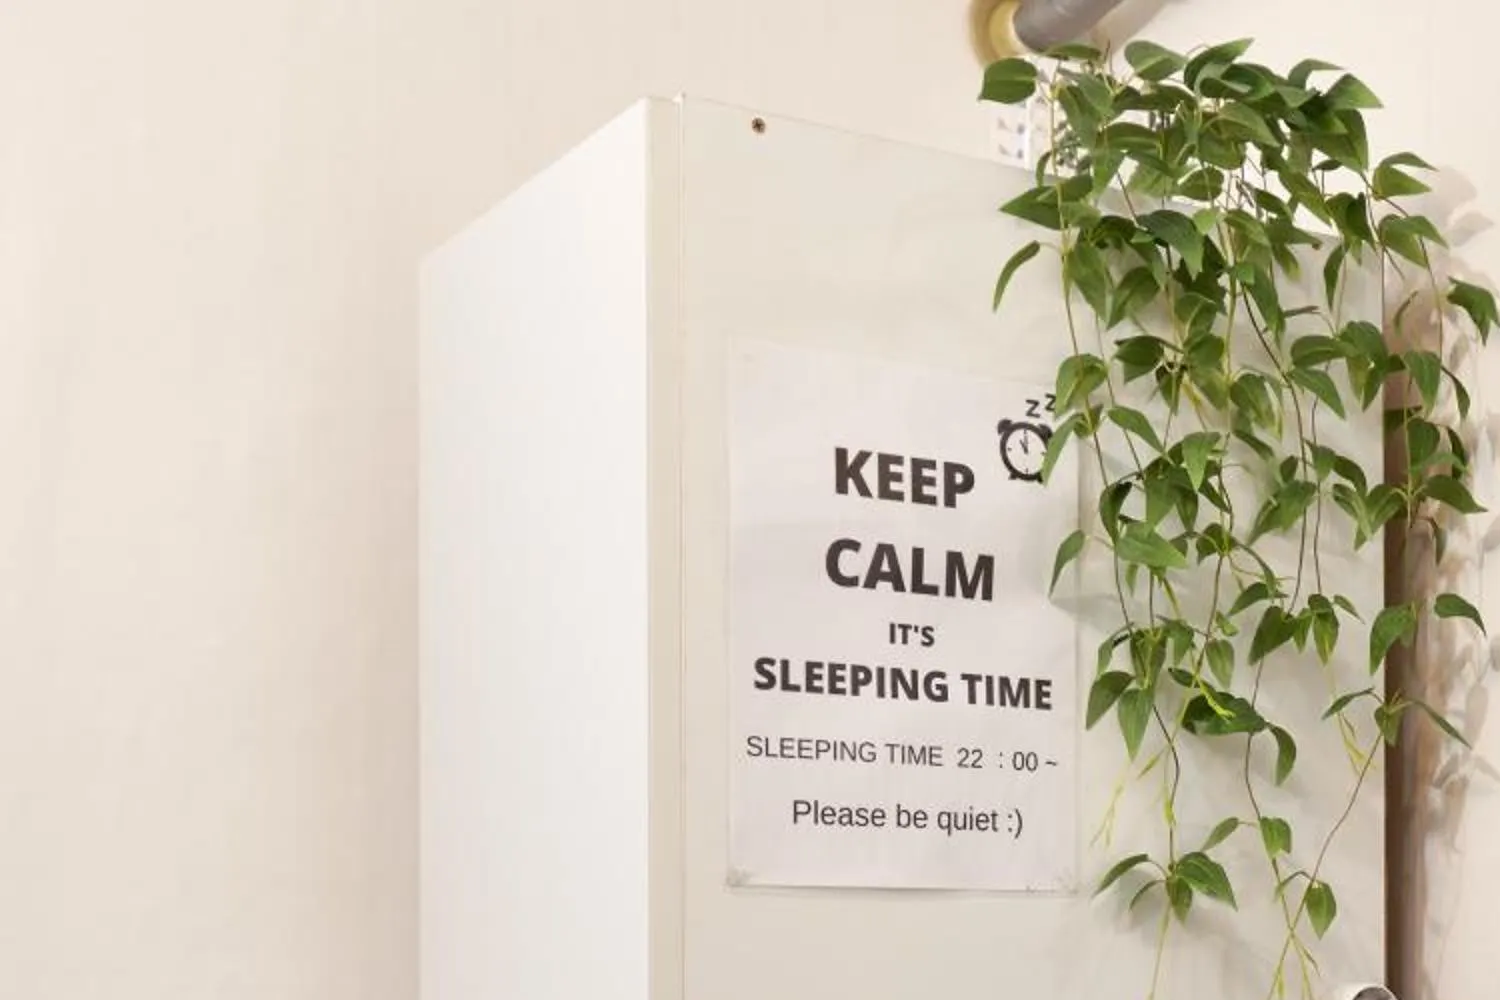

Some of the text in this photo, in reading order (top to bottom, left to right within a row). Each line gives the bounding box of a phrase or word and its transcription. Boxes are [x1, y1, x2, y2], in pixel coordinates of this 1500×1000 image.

[834, 446, 975, 508] KEEP
[825, 538, 994, 601] CALM
[889, 622, 935, 647] IT'S
[753, 656, 1053, 710] SLEEPING TIME
[746, 735, 877, 763] SLEEPING
[884, 743, 943, 767] TIME
[957, 747, 983, 769] 22
[792, 799, 887, 828] Please
[896, 803, 929, 829] be
[937, 805, 999, 837] quiet
